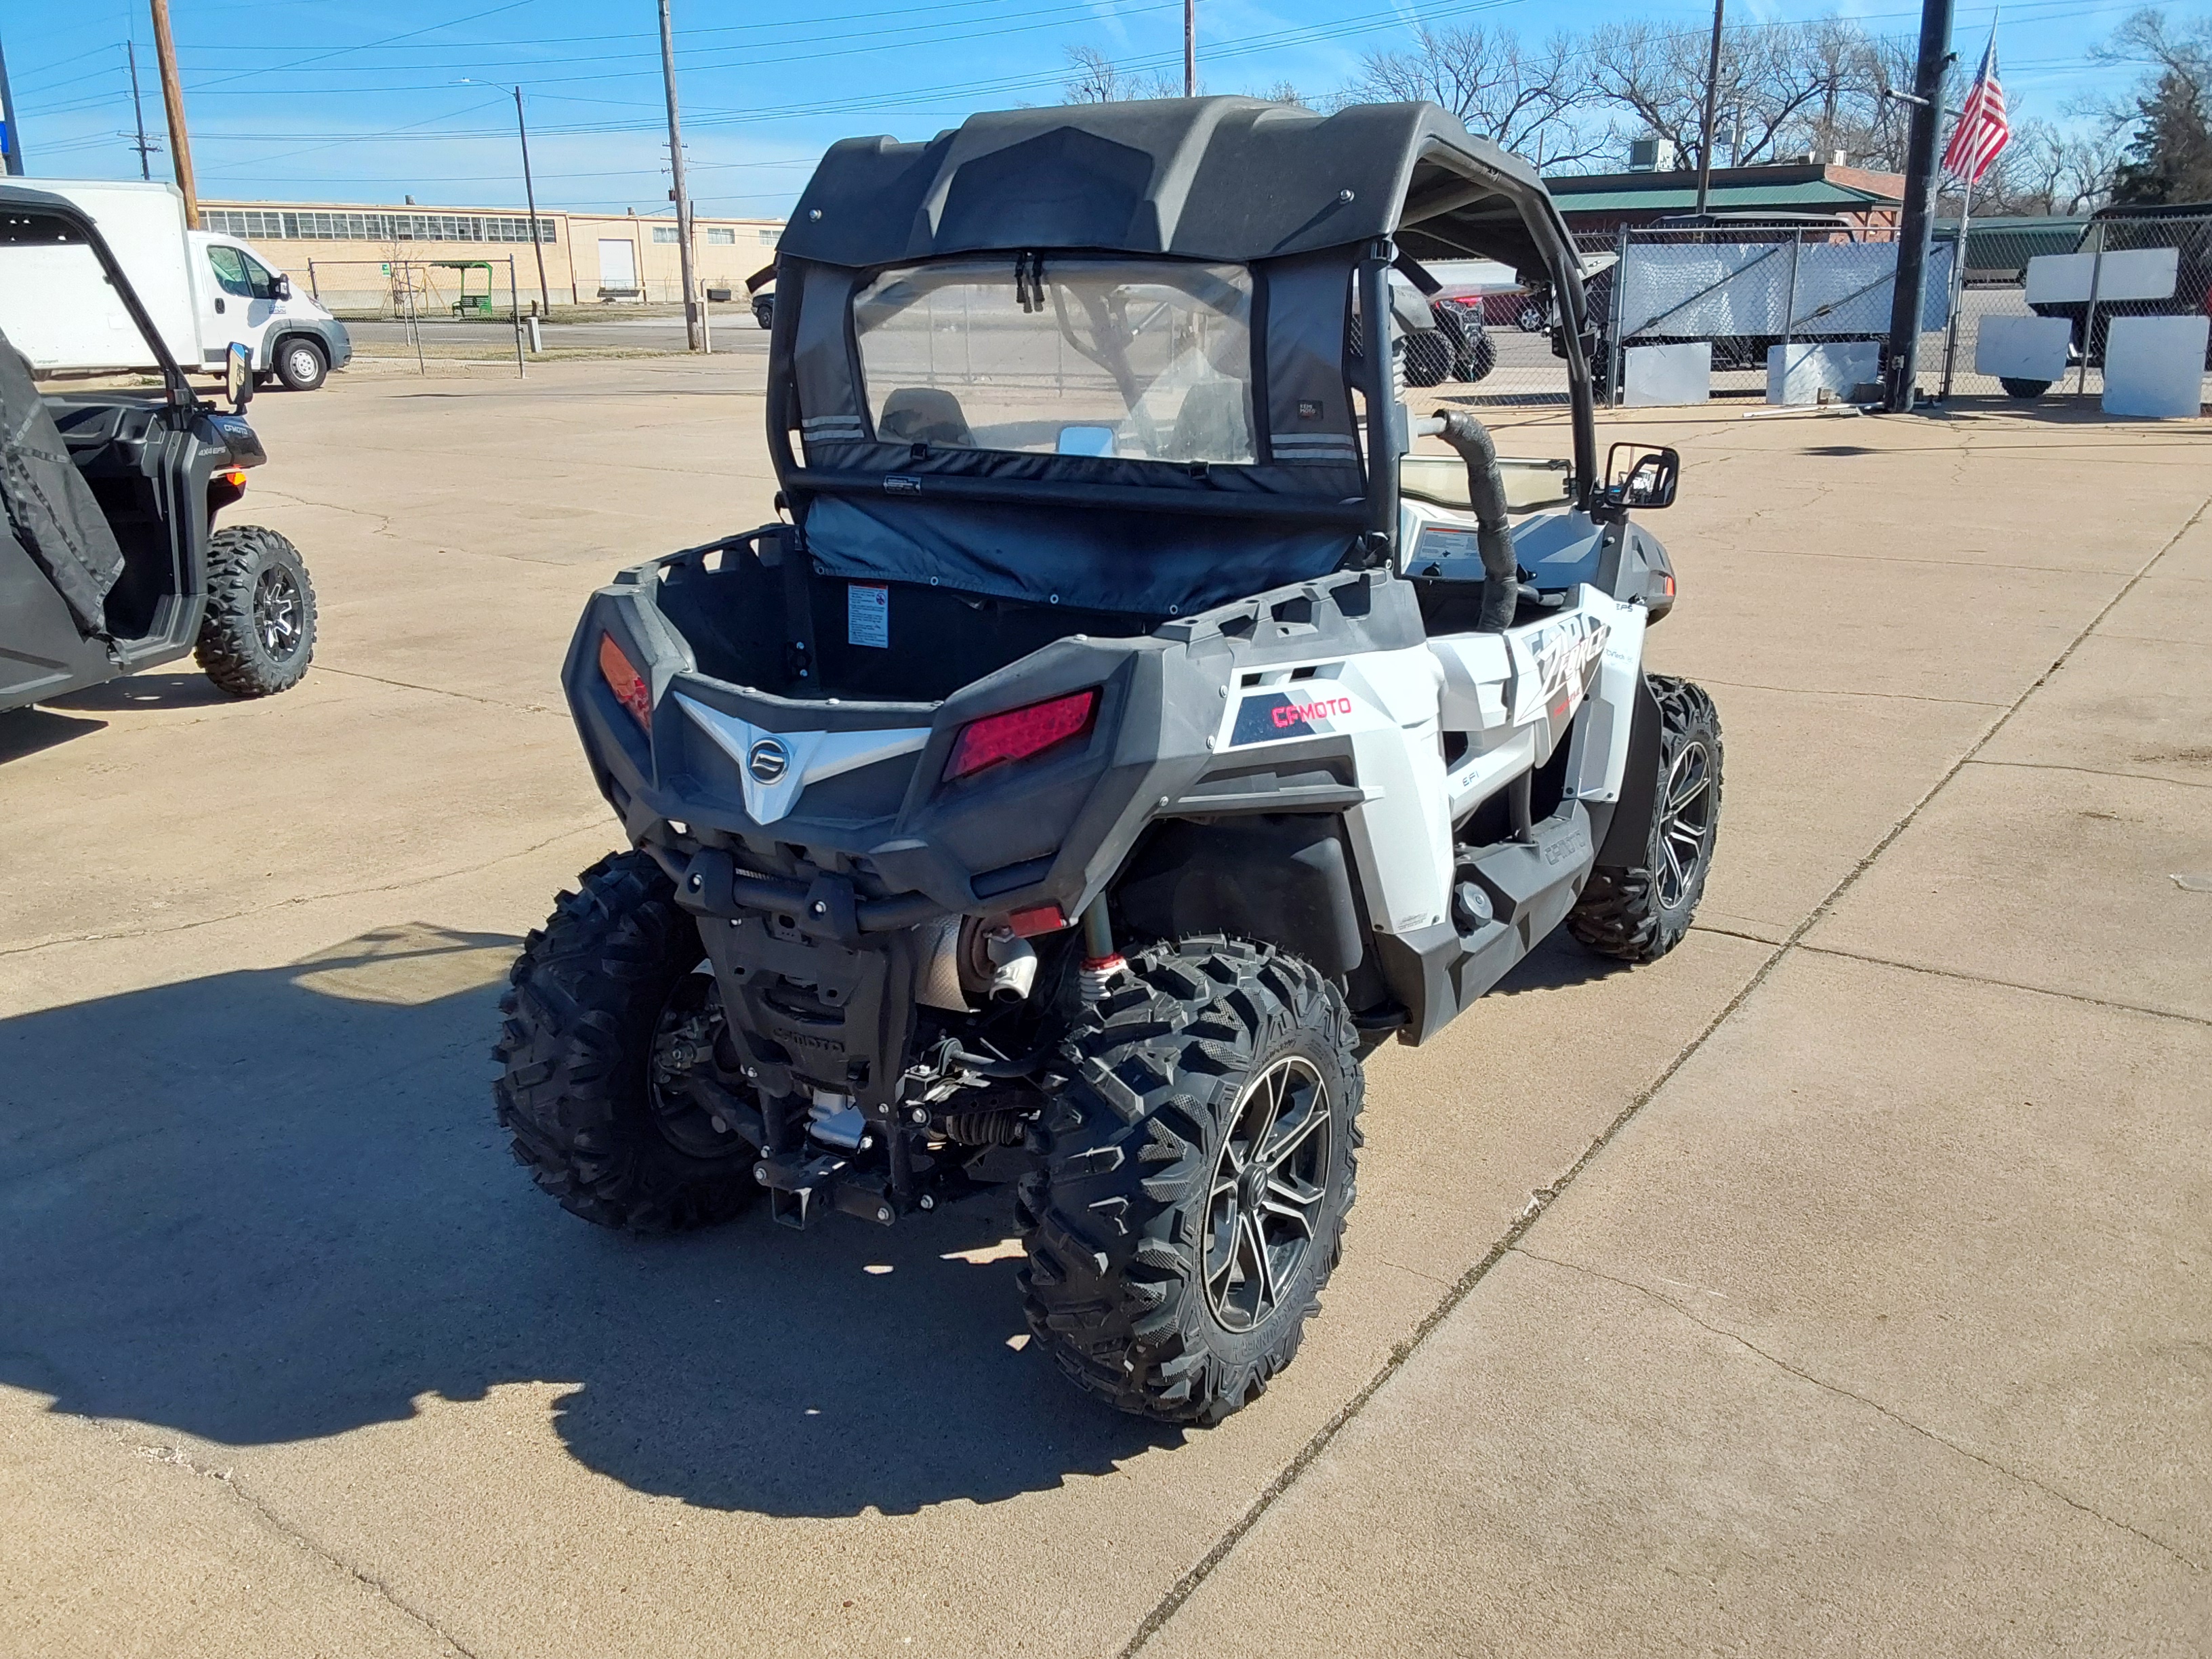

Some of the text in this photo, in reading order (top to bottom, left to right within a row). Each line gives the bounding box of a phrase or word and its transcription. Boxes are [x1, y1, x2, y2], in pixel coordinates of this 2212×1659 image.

[224, 424, 248, 434] CFMOTO
[198, 447, 213, 456] 4X4
[1616, 603, 1633, 612] EPS
[1271, 697, 1351, 729] CFMOTO
[1462, 771, 1479, 787] EFI
[1544, 830, 1586, 865] CFMOTO
